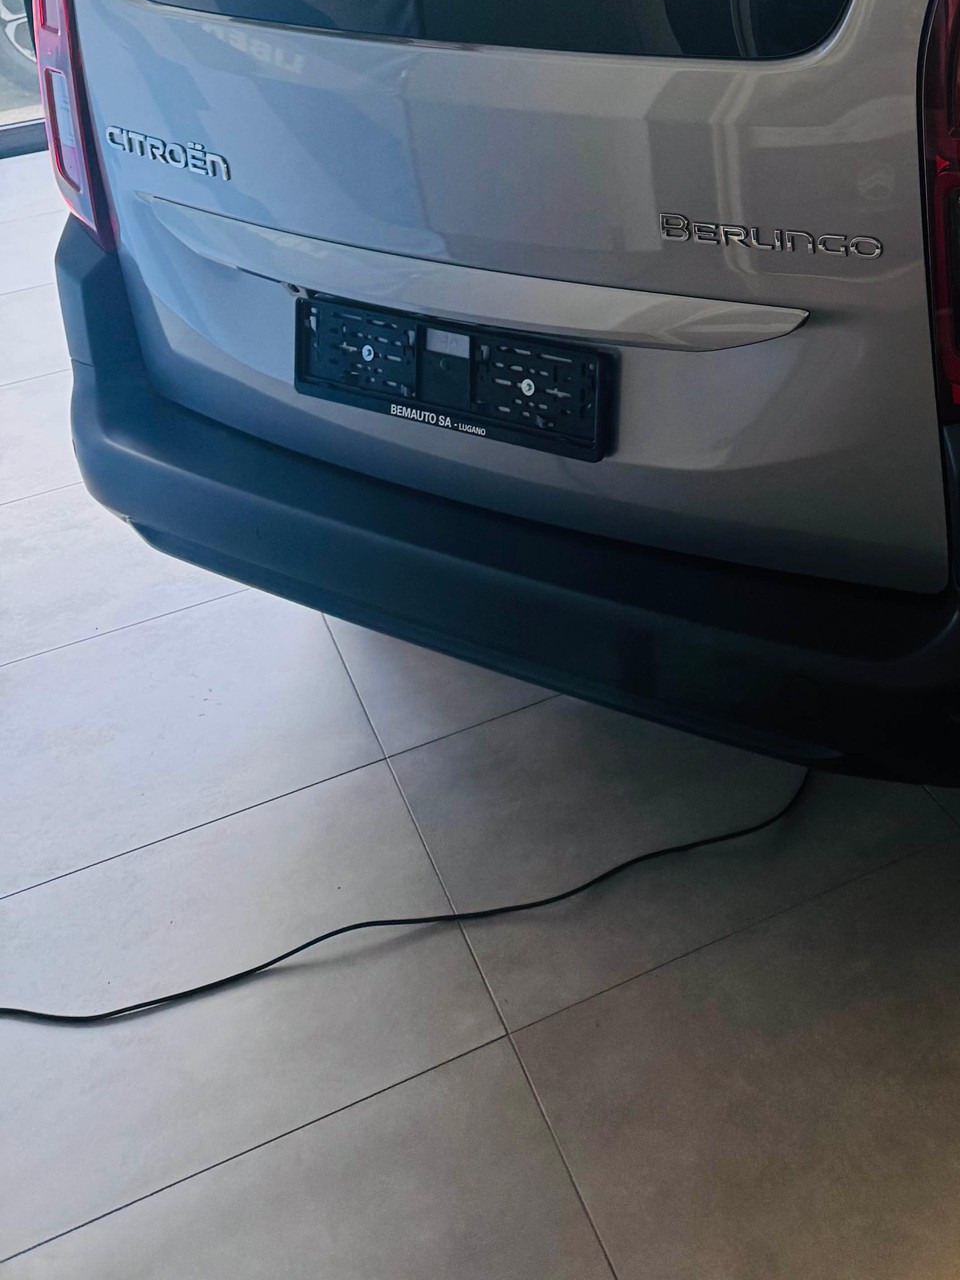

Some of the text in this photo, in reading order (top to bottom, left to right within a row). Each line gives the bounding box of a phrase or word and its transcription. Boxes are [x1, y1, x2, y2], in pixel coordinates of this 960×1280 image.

[106, 125, 231, 181] CITROËN
[659, 213, 883, 260] BERLINGO
[390, 404, 437, 424] BEMAUTO
[438, 415, 452, 428] SA
[458, 423, 486, 436] LUGANO
